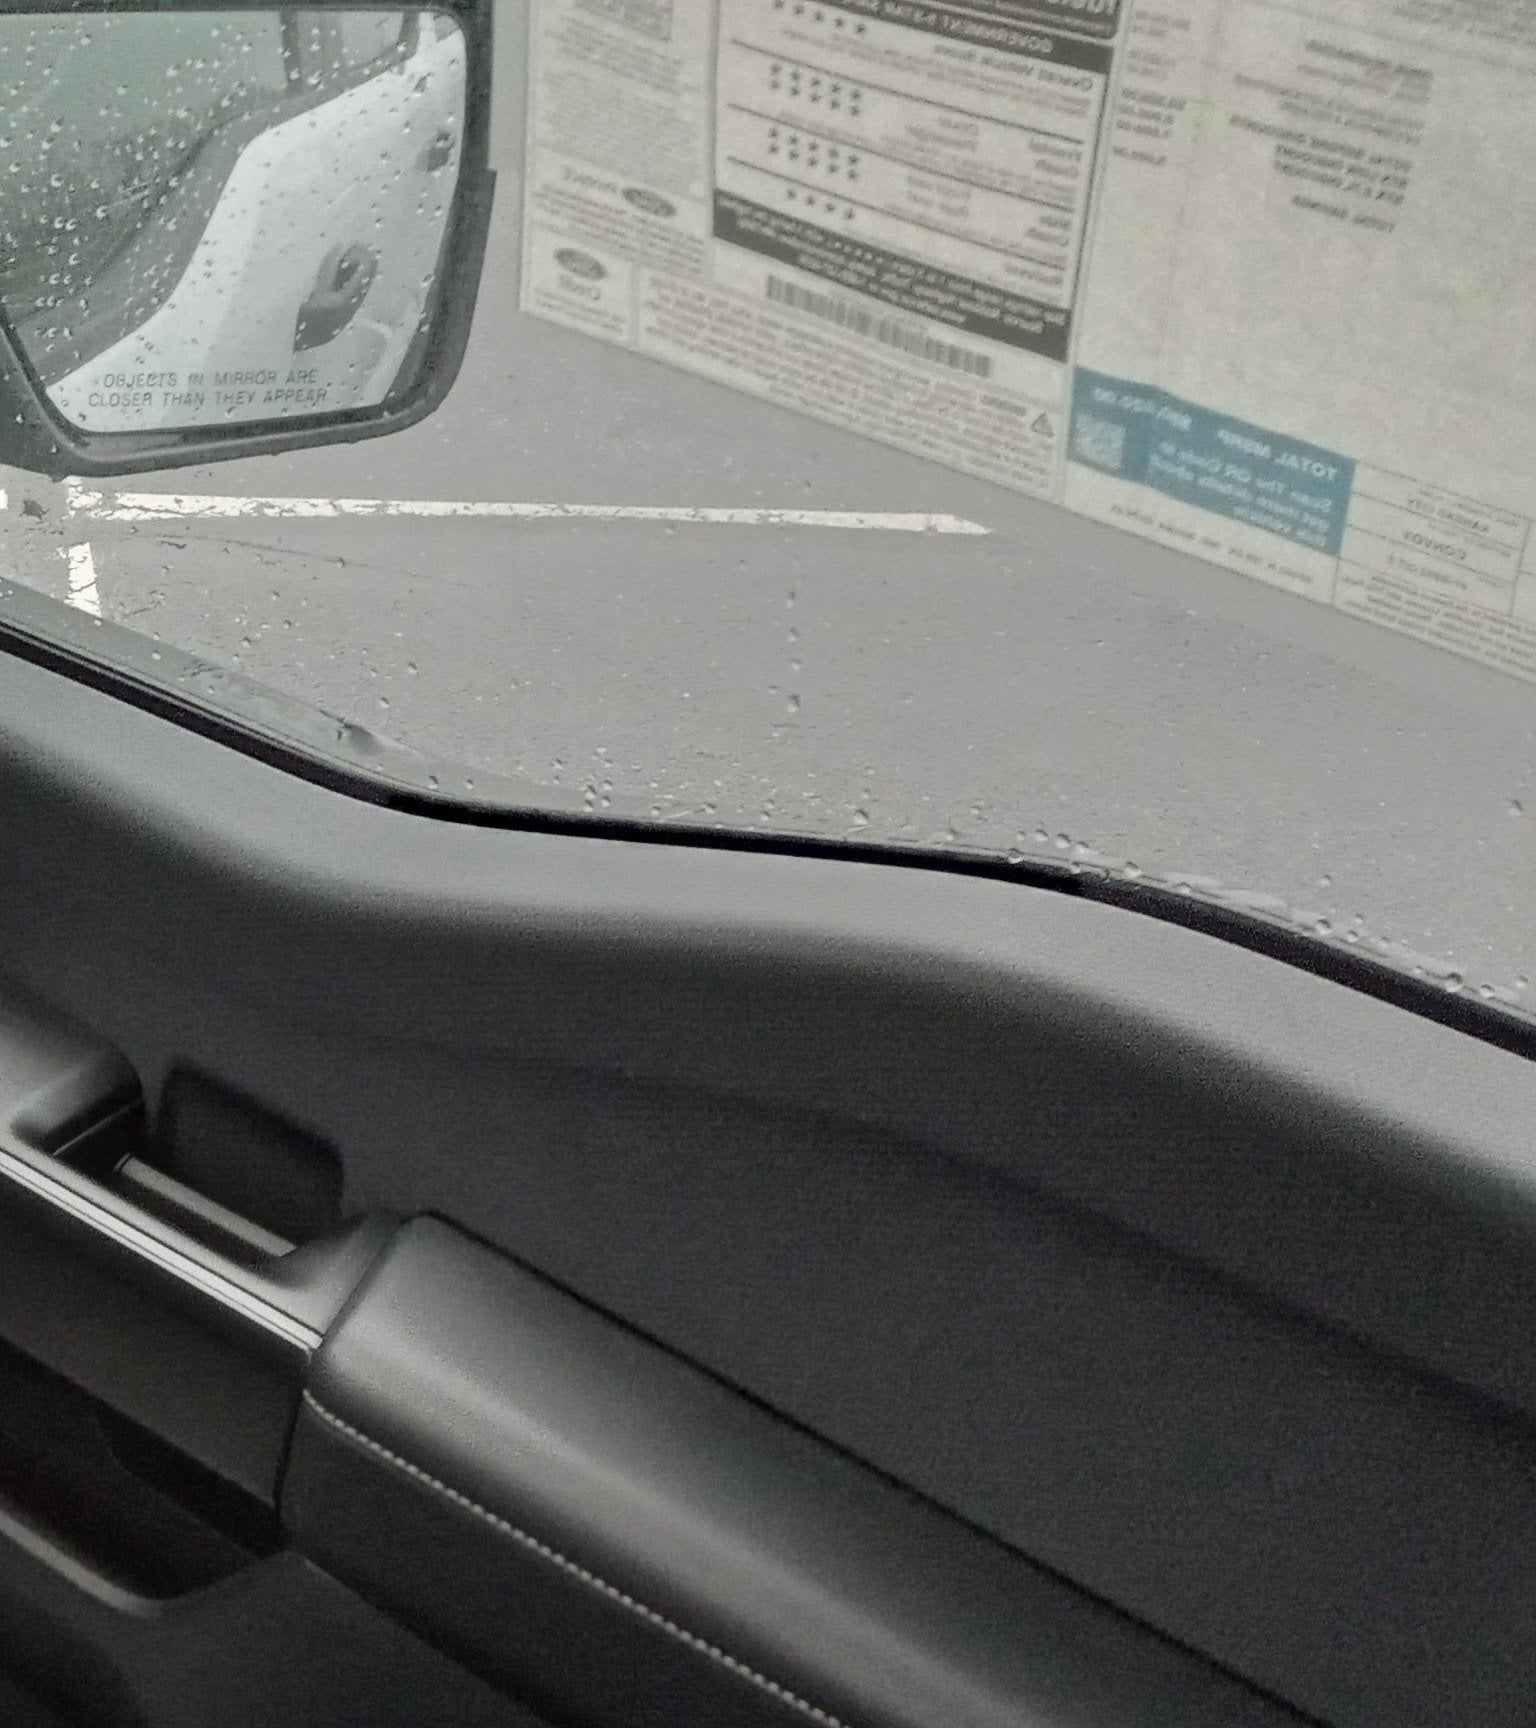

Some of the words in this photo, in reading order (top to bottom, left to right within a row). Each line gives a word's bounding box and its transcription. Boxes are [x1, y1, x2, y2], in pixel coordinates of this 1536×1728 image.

[103, 373, 177, 388] OBJECTS
[214, 369, 277, 386] MIRROR
[285, 368, 319, 384] ARE
[88, 391, 153, 407] CLOSER
[163, 391, 206, 406] THAN
[215, 390, 256, 405] THEY
[263, 388, 328, 403] APPEAR
